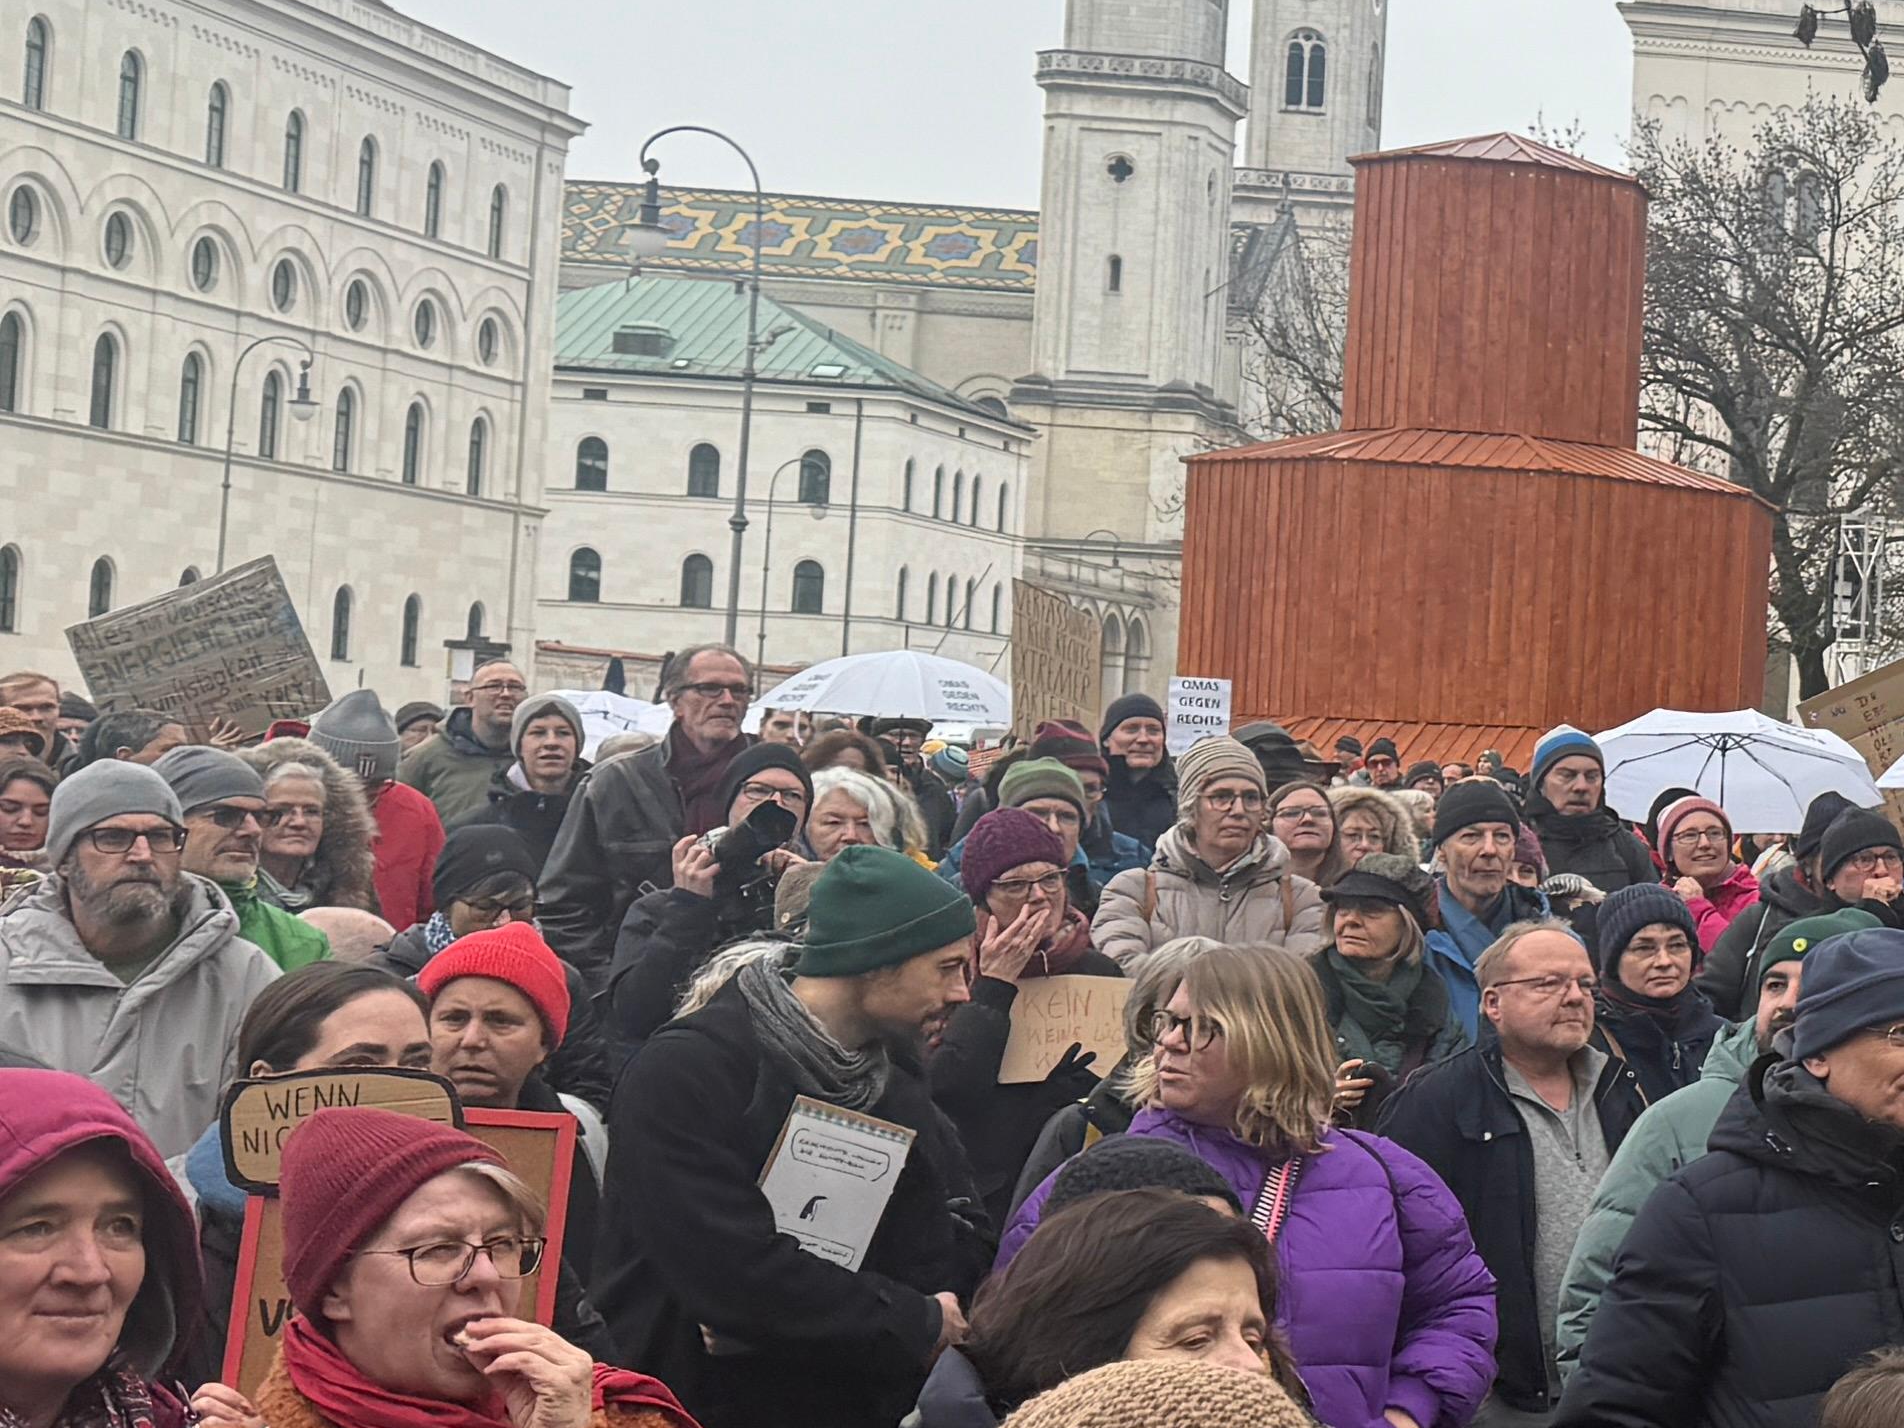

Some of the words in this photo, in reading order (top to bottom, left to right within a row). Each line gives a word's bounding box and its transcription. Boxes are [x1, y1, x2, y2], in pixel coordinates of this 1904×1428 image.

[1181, 680, 1220, 691] OMAS
[1179, 696, 1220, 709] GEGEN
[1176, 714, 1223, 726] RECHTS
[1022, 987, 1092, 1019] KEIN
[264, 1083, 360, 1120] WENN
